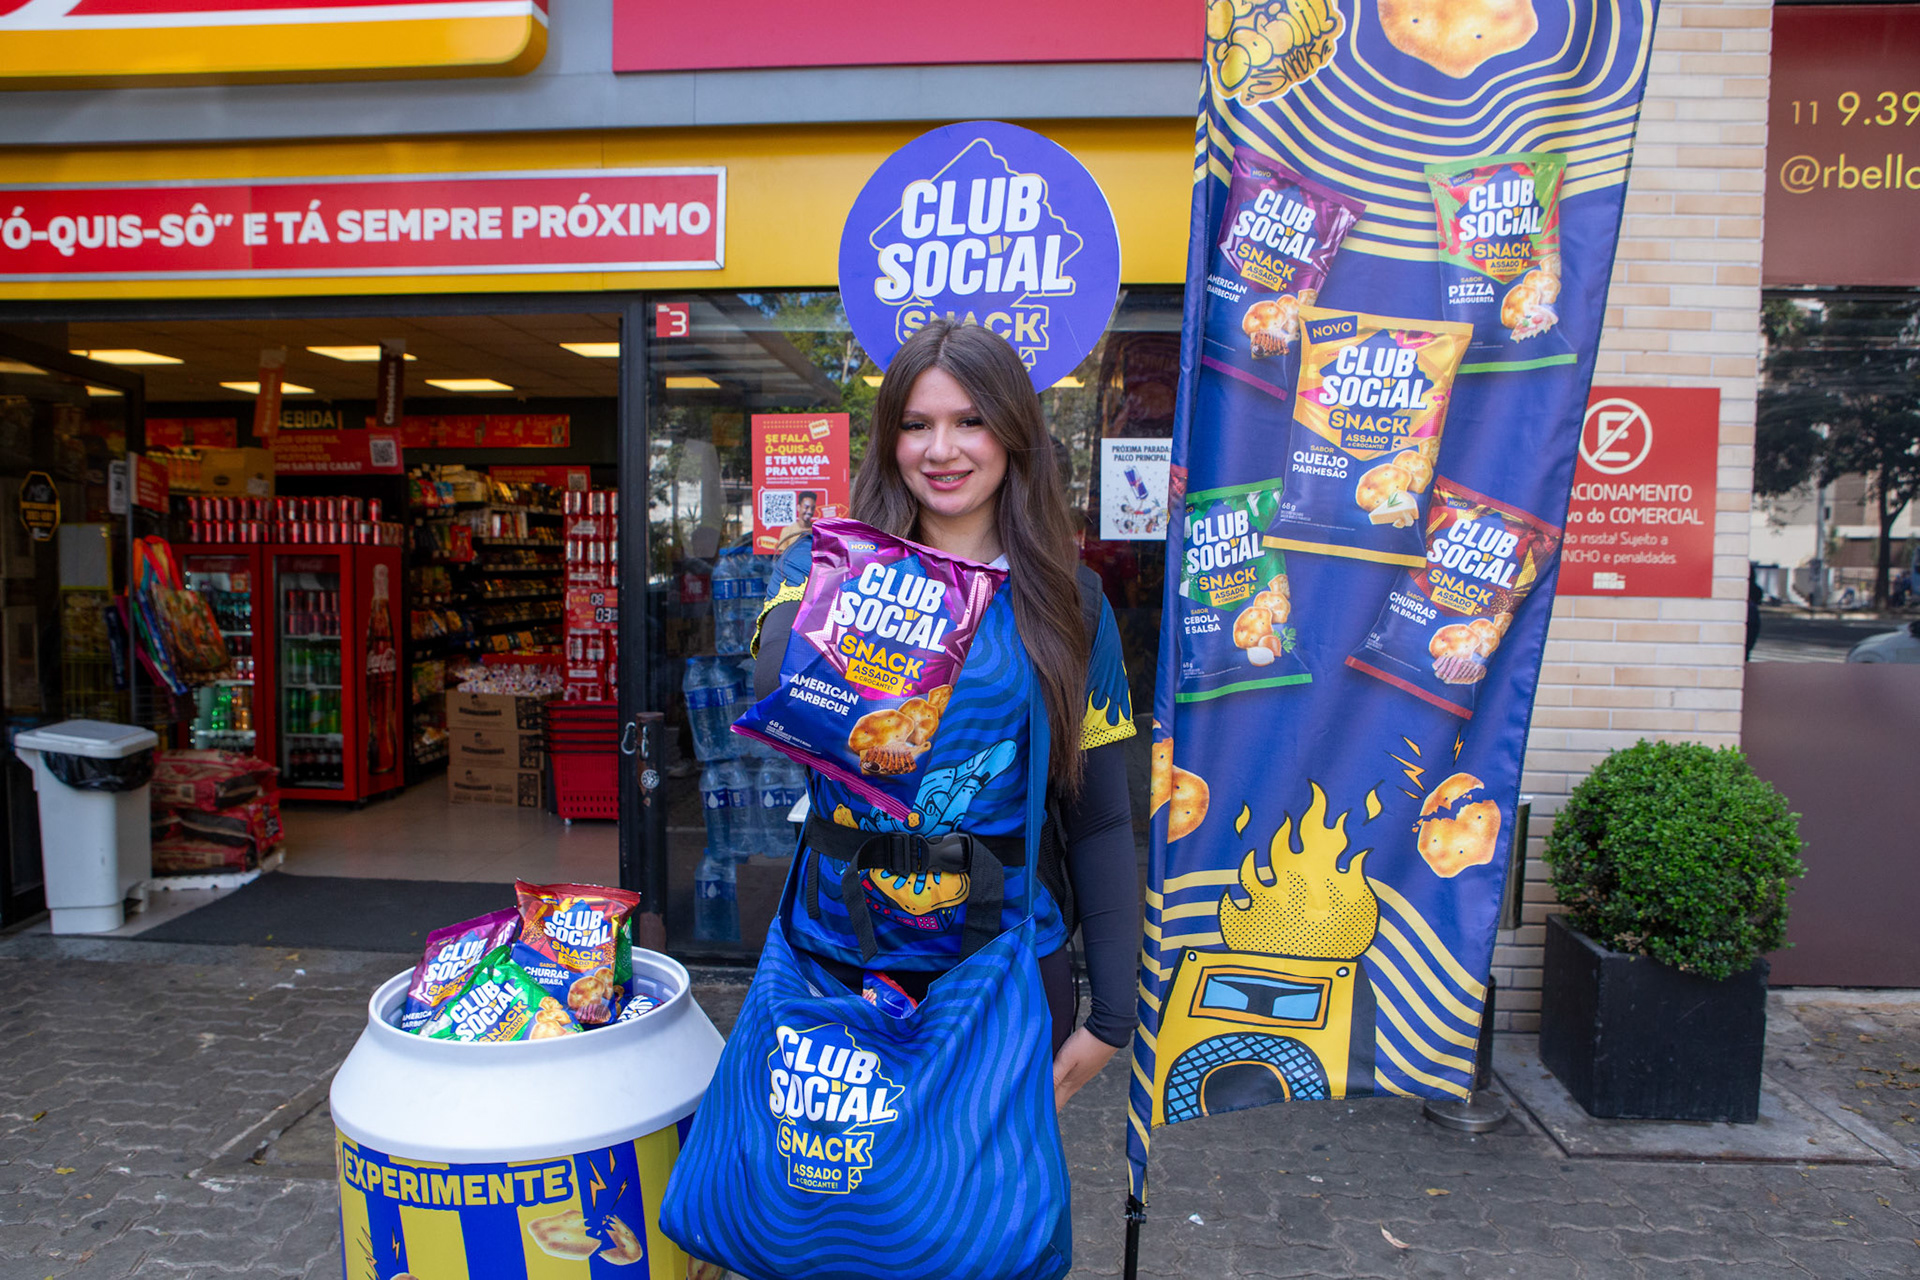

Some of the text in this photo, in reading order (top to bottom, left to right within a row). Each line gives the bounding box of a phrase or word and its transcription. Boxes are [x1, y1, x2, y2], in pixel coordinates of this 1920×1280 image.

[1791, 101, 1818, 125] 11
[1469, 179, 1535, 213] CLUB
[901, 175, 1043, 239] CLUB
[1254, 188, 1316, 233] CLUB
[243, 212, 267, 245] E
[274, 199, 330, 245] TÁ
[336, 205, 502, 244] SEMPRE
[512, 192, 711, 239] PRÓXIMO
[1474, 243, 1531, 258] SNACK
[1238, 243, 1297, 281] SNACK
[1491, 260, 1519, 268] ASSADO
[1207, 273, 1248, 294] AMERICAN
[1247, 266, 1278, 284] ASSADO
[1206, 284, 1241, 302] BARBECUE
[1448, 283, 1494, 297] PIZZA
[669, 310, 687, 336] 3
[1312, 322, 1352, 338] NOVO
[1336, 345, 1417, 377] CLUB
[1331, 411, 1409, 434] SNACK
[765, 434, 810, 443] SE FALA
[1112, 444, 1142, 453] PRÓXIMA
[1345, 434, 1388, 444] ASSADO
[1310, 445, 1334, 453] SABOR
[765, 455, 829, 465] E TEM VAGA
[1293, 451, 1348, 468] QUEIJO
[765, 464, 820, 476] PRA VOCÊ
[1292, 464, 1347, 479] PARMESÃO
[1587, 507, 1605, 523] do
[1610, 507, 1704, 525] COMERCIAL
[1192, 509, 1249, 546] CLUB
[1448, 518, 1519, 558] CLUB
[1620, 531, 1657, 547] Sujeito
[1660, 536, 1668, 545] a
[1603, 553, 1611, 563] e
[858, 562, 946, 614] CLUB
[1200, 567, 1257, 591] SNACK
[1429, 570, 1493, 605] SNACK
[1215, 586, 1246, 600] ASSADO
[1437, 590, 1472, 609] ASSADO
[1389, 592, 1437, 620] CHURRAS
[1389, 603, 1427, 625] NA BRASA
[1184, 614, 1220, 625] CEBOLA
[1192, 623, 1221, 634] SALSA
[841, 635, 925, 679] SNACK
[852, 665, 898, 685] ASSADO
[859, 676, 893, 691] CROCANTE!
[789, 673, 859, 705] AMERICAN
[789, 688, 850, 716] BARBECUE
[552, 910, 604, 930] CLUB
[552, 940, 602, 960] SNACK
[524, 966, 569, 979] CHURRAS
[539, 978, 564, 986] BRASA
[450, 980, 500, 1023] CLUB
[776, 1025, 877, 1085] CLUB
[781, 1126, 867, 1163] SNACK
[344, 1148, 568, 1206] EXPERIMENTE
[794, 1163, 842, 1181] ASSADO
[800, 1177, 838, 1189] CROCANTE!
